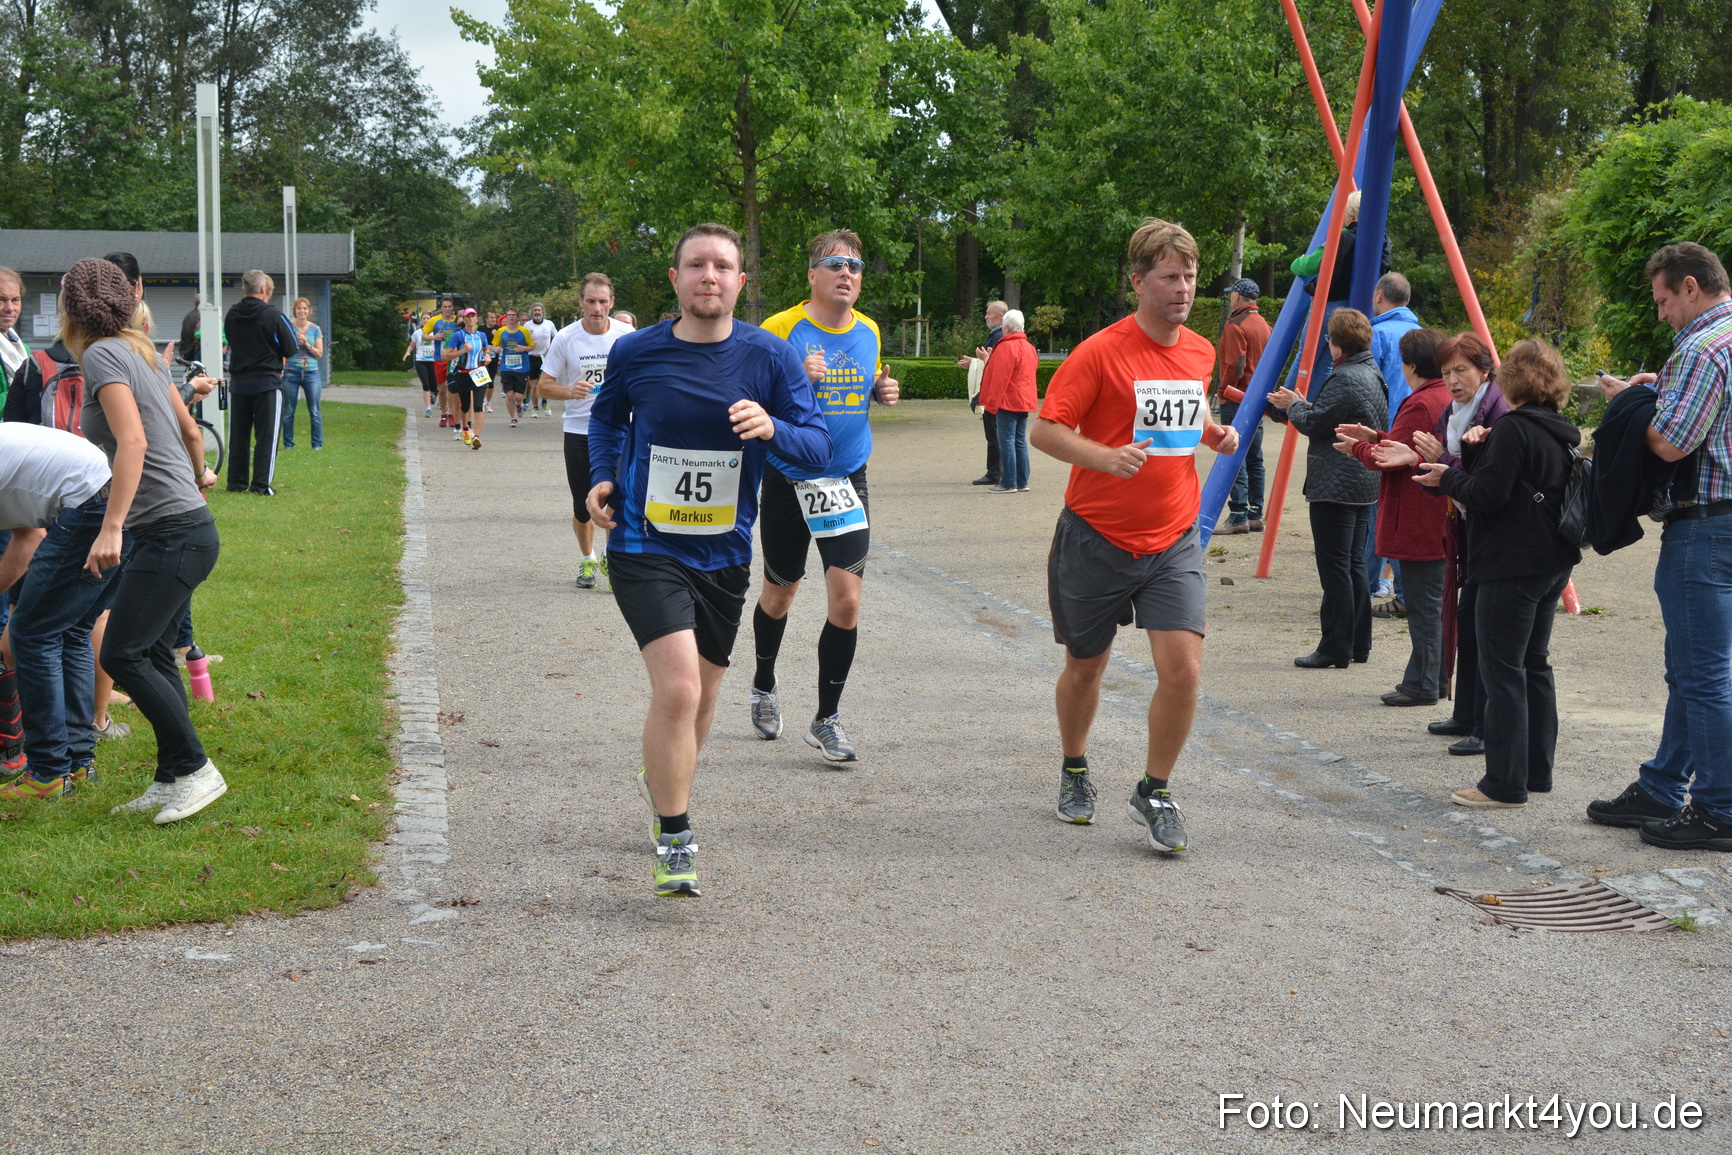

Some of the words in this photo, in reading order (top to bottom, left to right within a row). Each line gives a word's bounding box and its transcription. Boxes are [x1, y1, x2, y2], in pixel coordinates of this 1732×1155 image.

[1136, 387, 1161, 395] PARTL
[1143, 398, 1200, 427] 3417
[652, 453, 680, 466] PARTL
[681, 458, 726, 468] Neumarkt
[674, 471, 712, 503] 45
[804, 488, 855, 515] 2248
[669, 509, 713, 523] Markus
[823, 517, 846, 529] Armin
